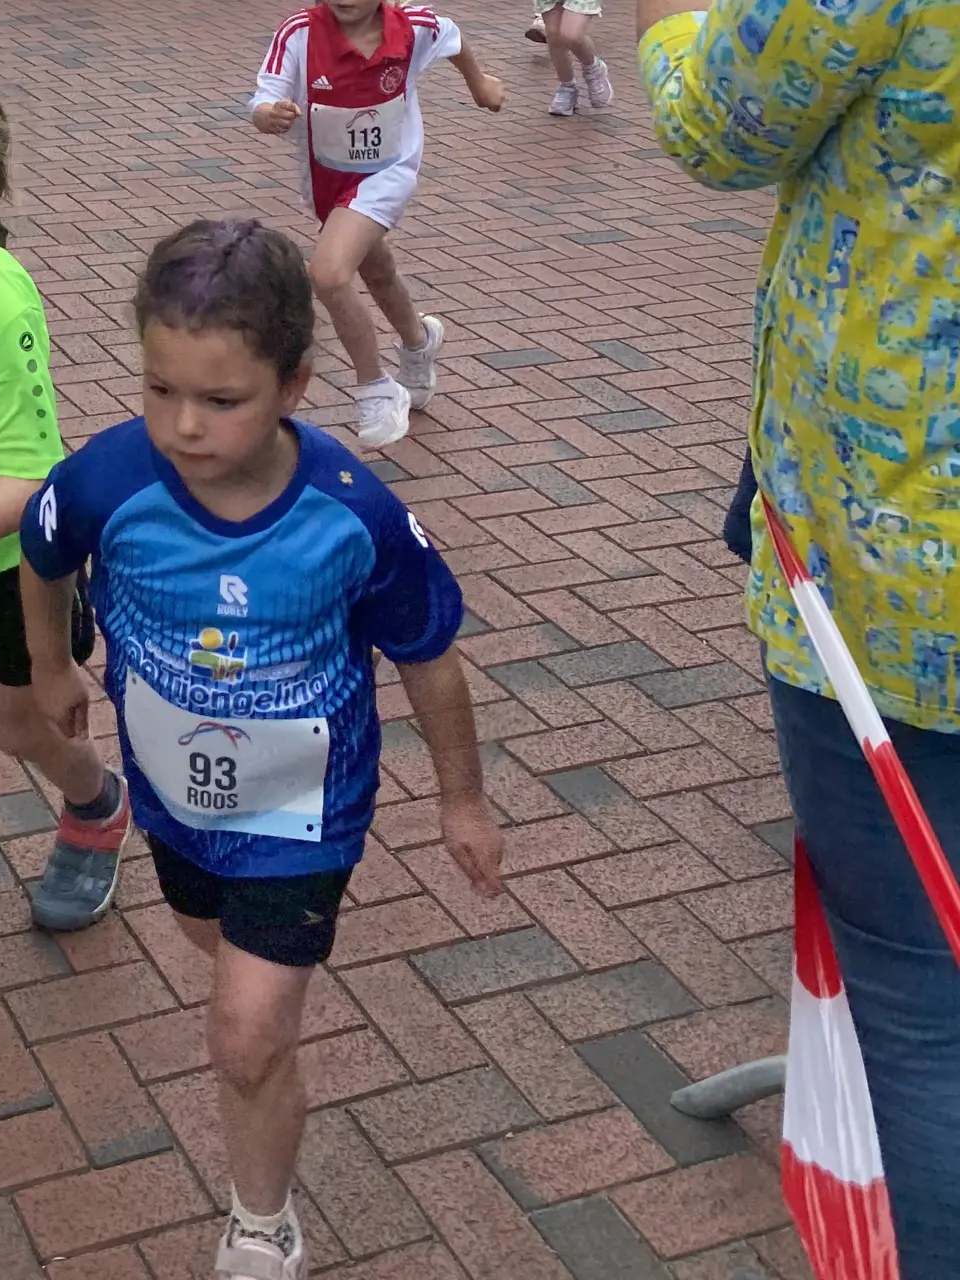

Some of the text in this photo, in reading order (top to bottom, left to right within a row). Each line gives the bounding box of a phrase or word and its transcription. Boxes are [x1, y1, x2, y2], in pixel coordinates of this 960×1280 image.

[347, 126, 382, 148] 113
[348, 148, 380, 160] VAYEN
[189, 751, 237, 791] 93
[186, 786, 239, 810] ROOS
